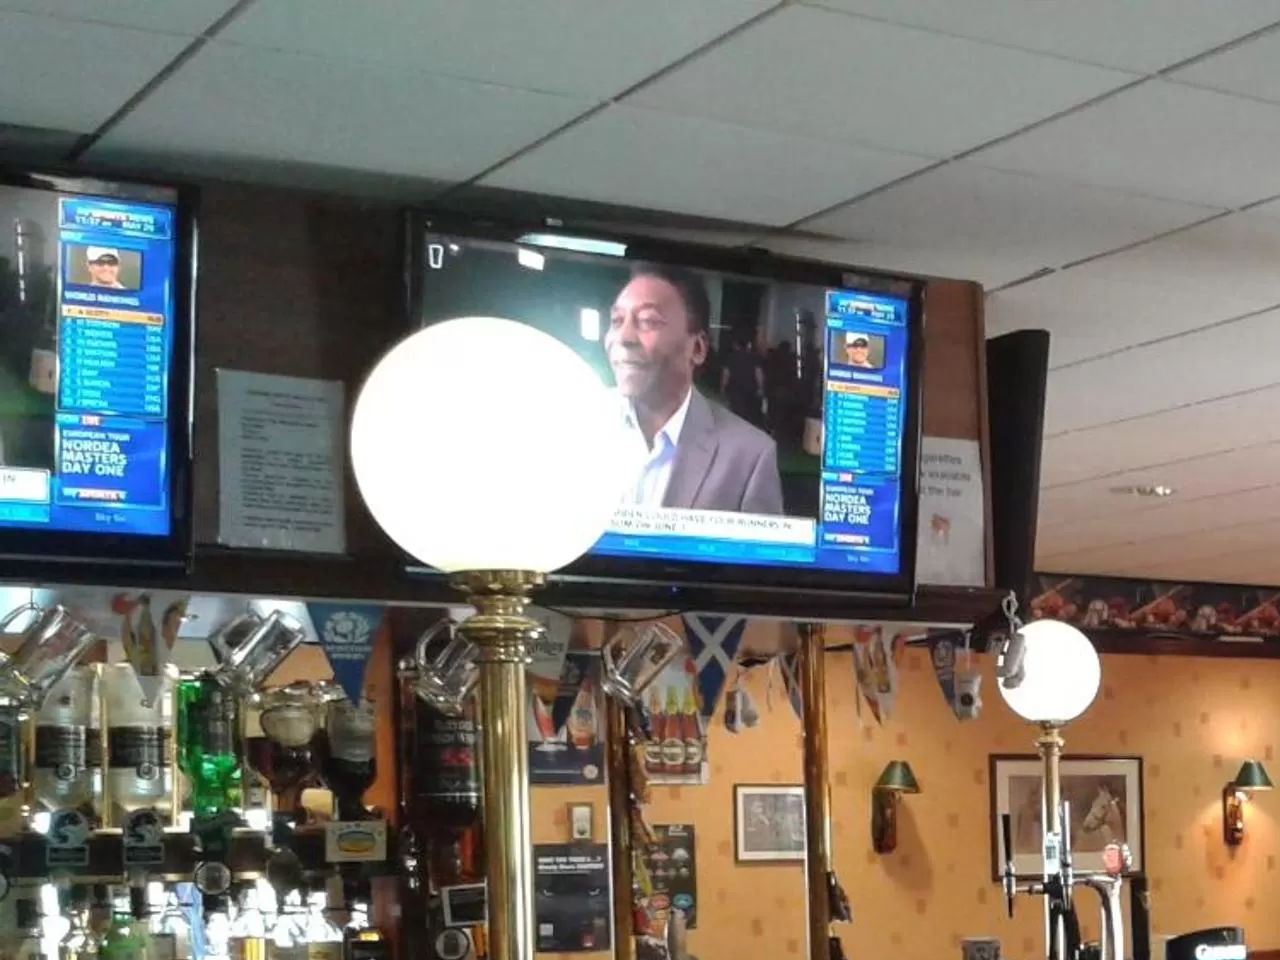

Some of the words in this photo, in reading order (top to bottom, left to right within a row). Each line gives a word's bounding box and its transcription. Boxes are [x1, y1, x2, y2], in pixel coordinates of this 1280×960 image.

[62, 440, 120, 453] NORDEA
[62, 451, 127, 465] MASTERS
[62, 462, 90, 475] DAY
[95, 464, 124, 477] ONE
[825, 494, 866, 505] NORDEA
[825, 503, 871, 516] MASTERS
[824, 512, 846, 523] DAY
[848, 515, 869, 525] ONE
